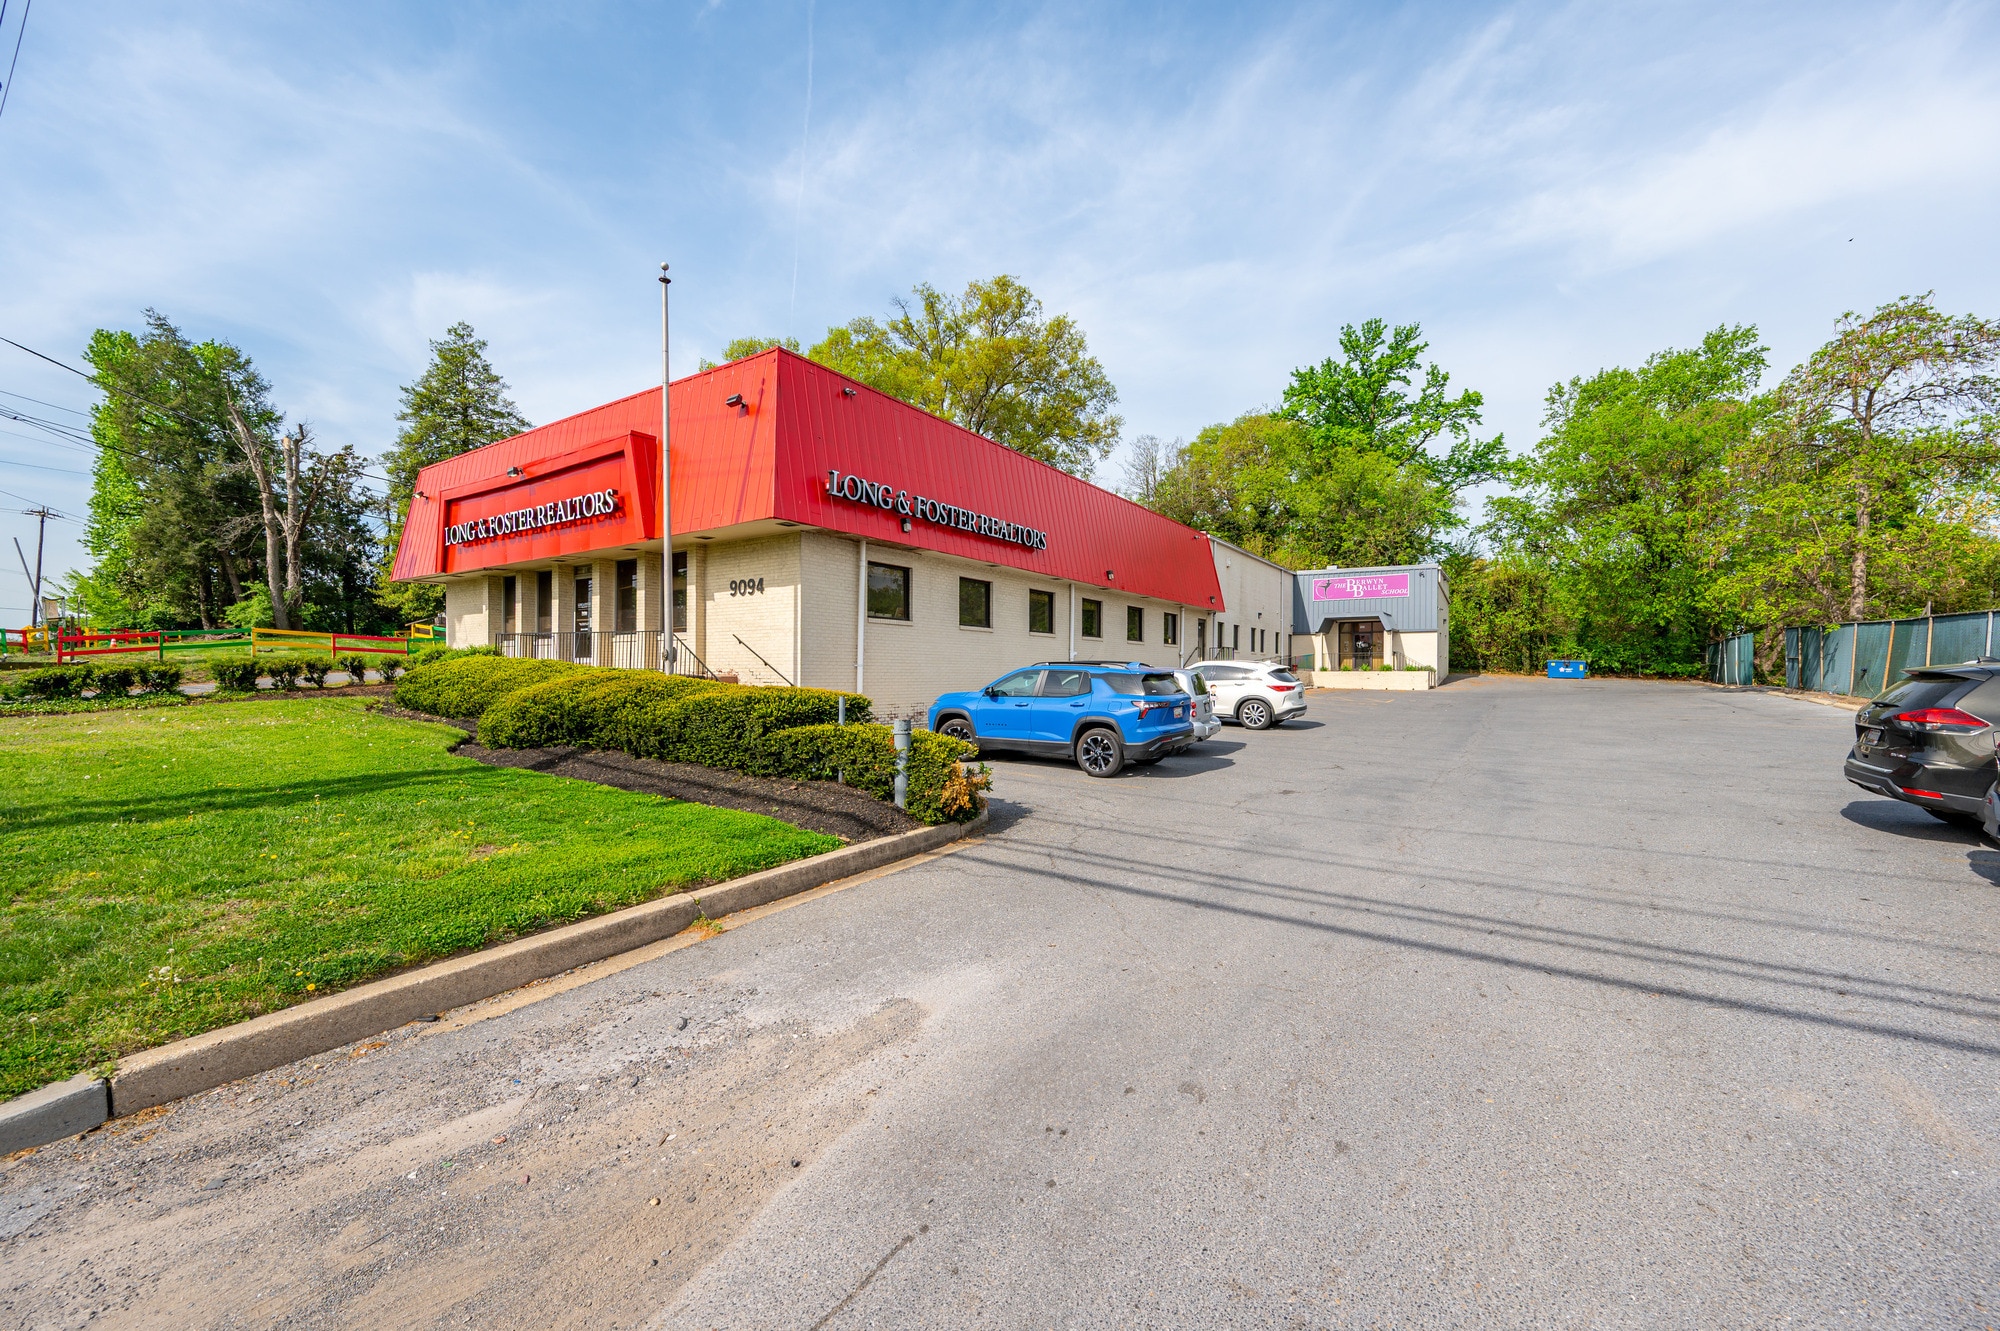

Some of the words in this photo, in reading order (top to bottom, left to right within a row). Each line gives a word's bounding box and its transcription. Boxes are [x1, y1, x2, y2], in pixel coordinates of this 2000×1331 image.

[444, 520, 475, 546] LONG
[477, 518, 487, 538] &
[488, 507, 535, 537] FOSTER
[536, 488, 616, 528] REALTORS
[828, 469, 893, 510] LONG
[896, 489, 913, 516] &
[914, 495, 978, 533] FOSTER
[979, 514, 1047, 550] REALTORS
[730, 578, 765, 597] 9094
[1346, 578, 1384, 592] BERWYN
[1353, 584, 1388, 597] BALLET
